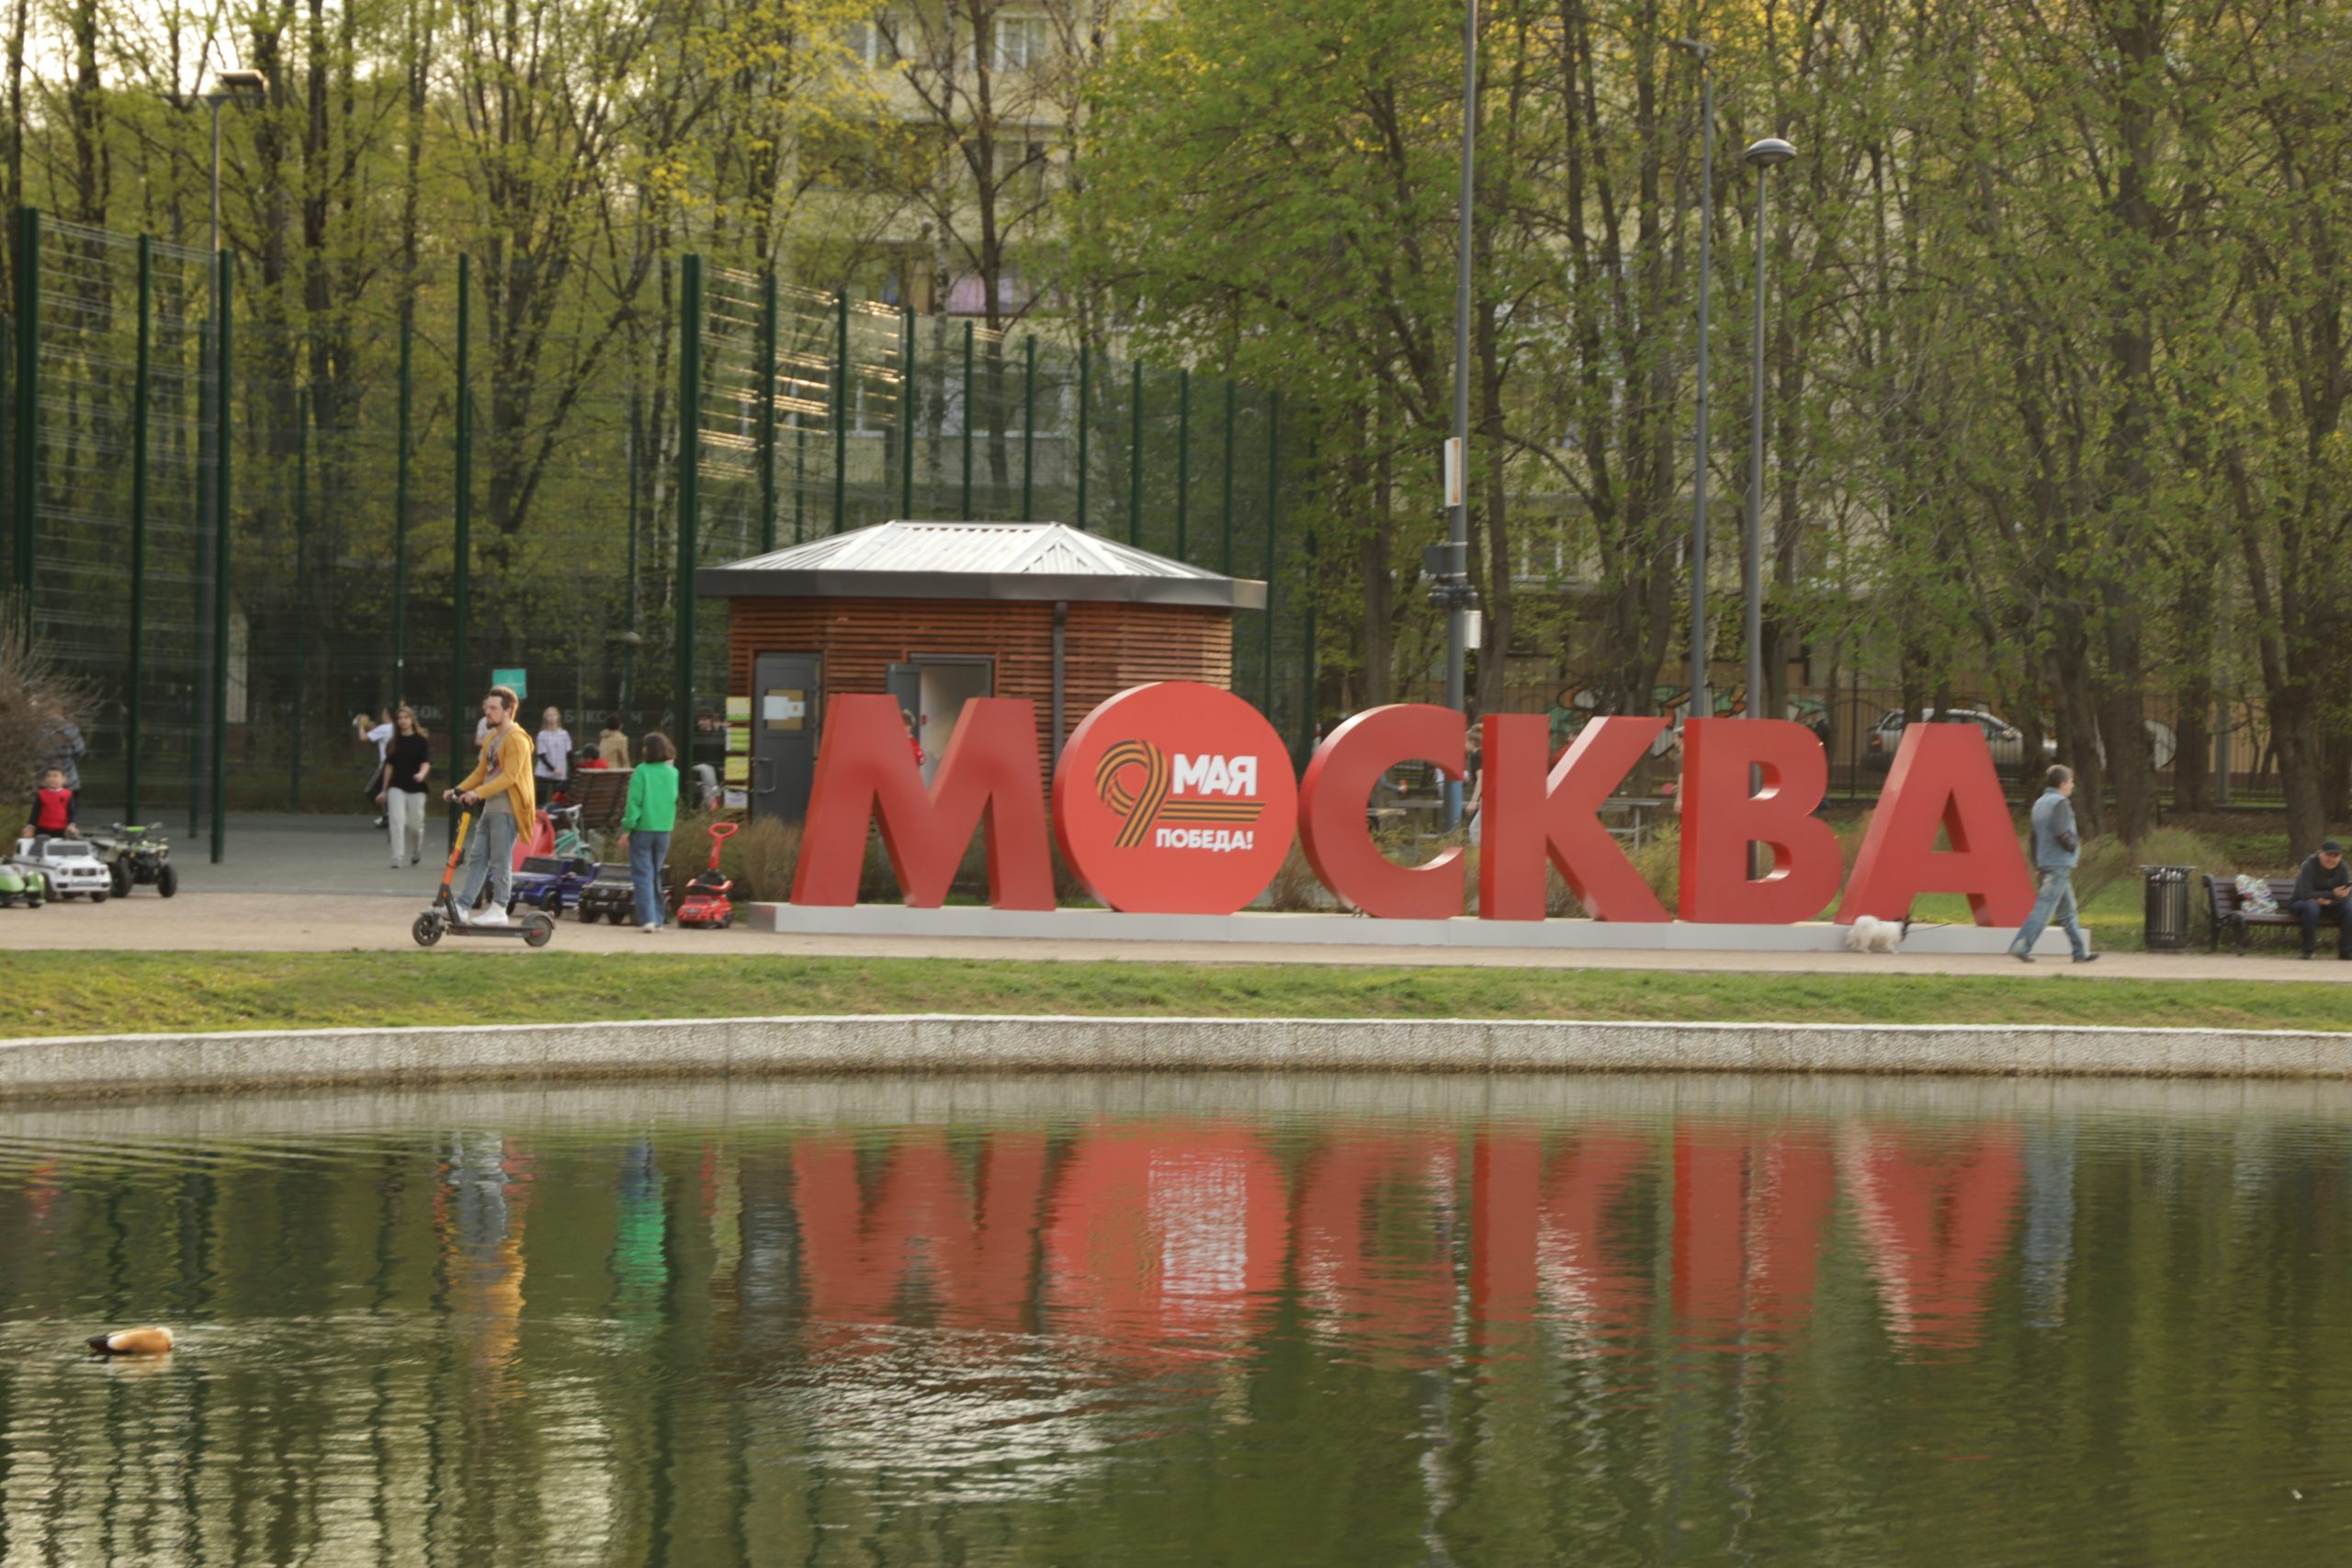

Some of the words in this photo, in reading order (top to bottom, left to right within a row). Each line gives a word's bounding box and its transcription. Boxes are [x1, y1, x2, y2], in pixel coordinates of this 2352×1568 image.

[790, 681, 2038, 928] МОСКВА
[1095, 739, 1171, 847] 9
[1172, 754, 1257, 795] МАЯ
[1155, 829, 1254, 852] ПОБЕДА!
